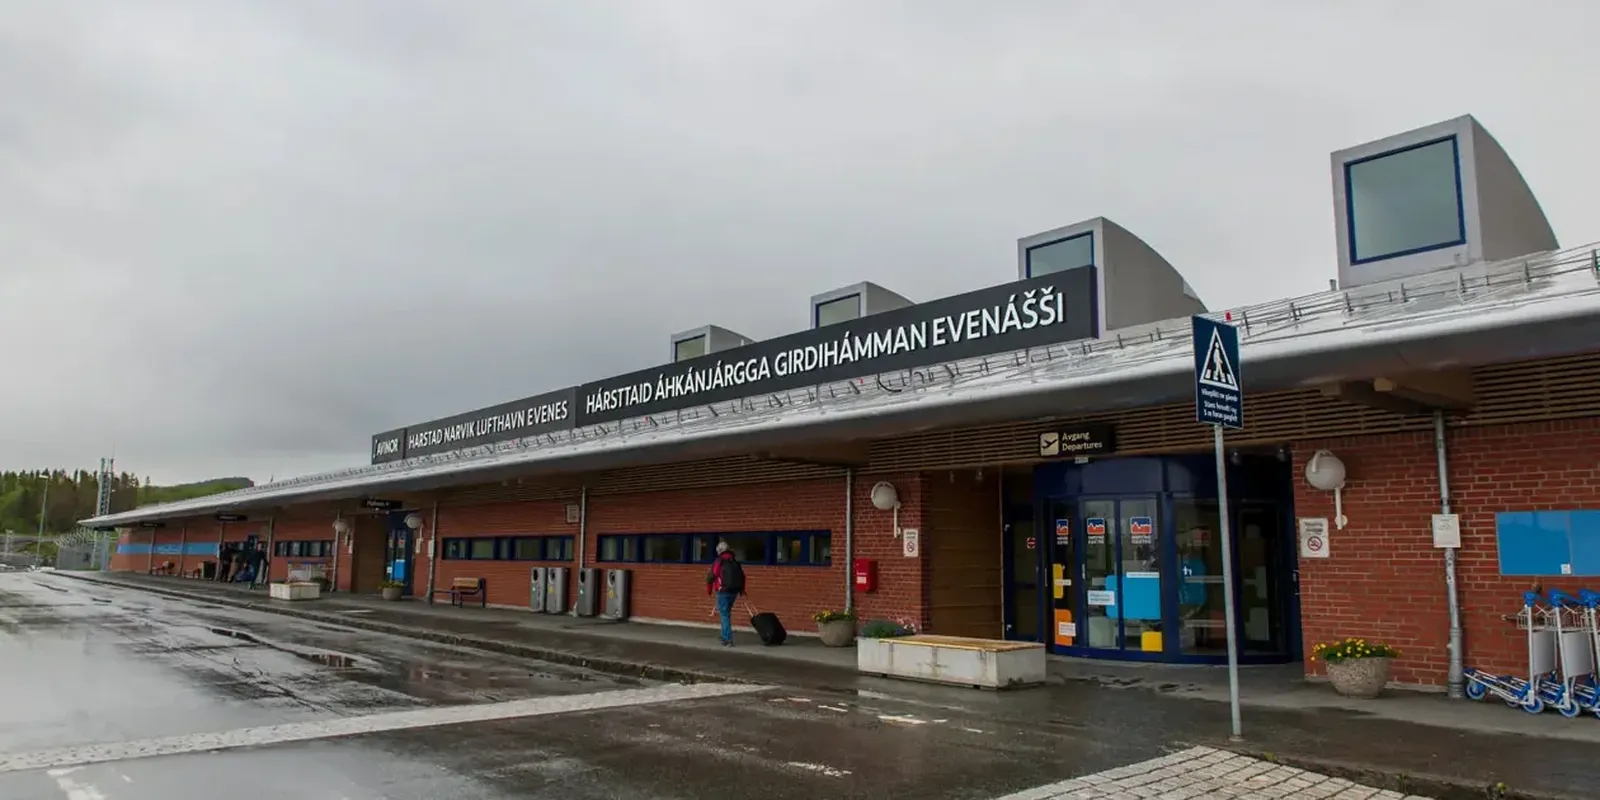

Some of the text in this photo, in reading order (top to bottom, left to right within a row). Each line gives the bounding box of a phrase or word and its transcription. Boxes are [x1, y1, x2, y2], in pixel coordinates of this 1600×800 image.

[586, 286, 1065, 414] HÁRSTTAID ÁHKÁNJÁRGGA GIRDIHÁMMAN EVENÁŠŠI
[408, 400, 568, 450] HARSTAD NARVIK LUFTHAVN EVENES
[1062, 431, 1091, 442] Avgang
[377, 439, 399, 455] AVINOR
[1062, 442, 1103, 452] Departures
